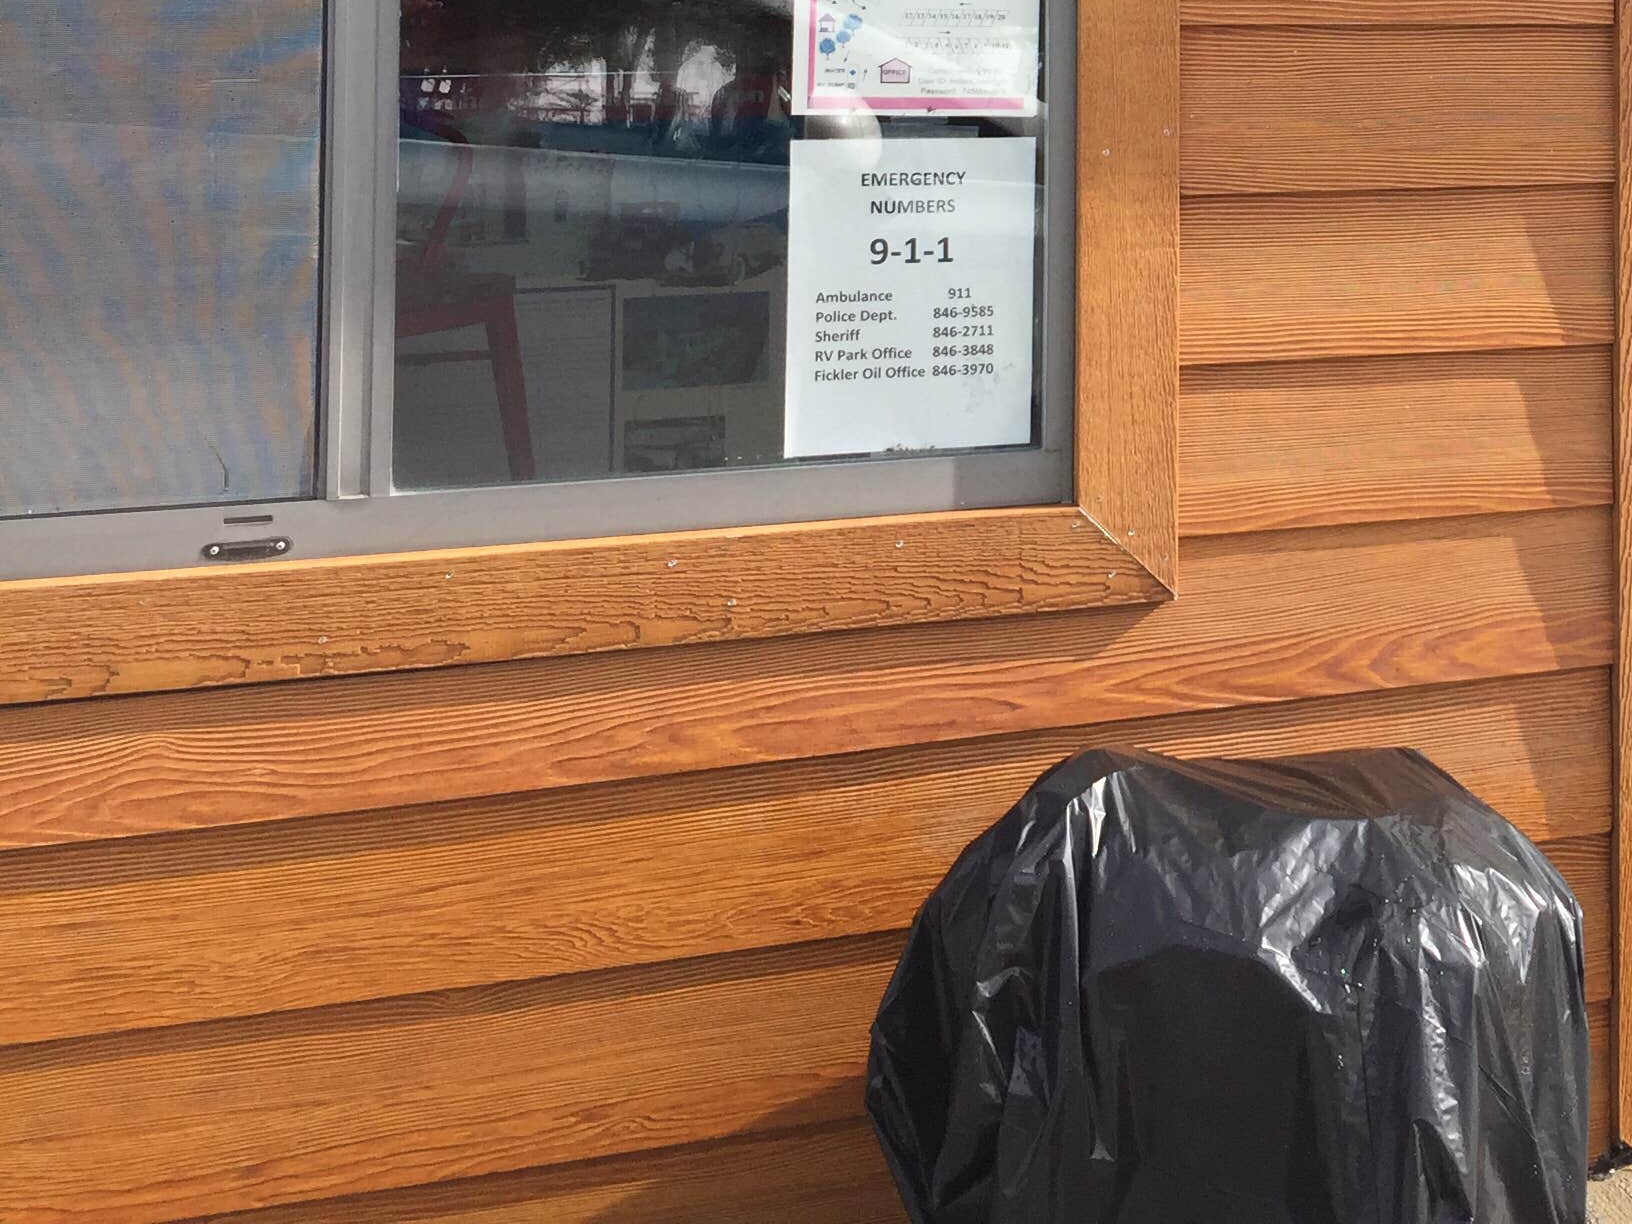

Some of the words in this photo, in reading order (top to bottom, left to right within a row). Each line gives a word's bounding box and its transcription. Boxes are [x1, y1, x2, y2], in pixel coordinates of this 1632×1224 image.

[860, 171, 966, 187] EMERGENCY
[870, 199, 956, 214] NUMBERS
[869, 237, 954, 265] 9-1-1
[815, 287, 893, 304] Ambulance
[947, 288, 971, 300] 911
[815, 309, 857, 323] Police
[860, 309, 897, 325] Dept.
[932, 306, 994, 319] 846-9585
[815, 329, 861, 343] Sheriff
[932, 324, 994, 338] 846-2711
[814, 350, 834, 362] RV
[837, 348, 868, 362] Park
[872, 347, 912, 360] Office
[932, 343, 994, 358] 846-3848
[814, 368, 858, 383] Fickler
[862, 366, 882, 380] Oil
[885, 365, 925, 379] Office
[931, 362, 994, 376] 846-3970
